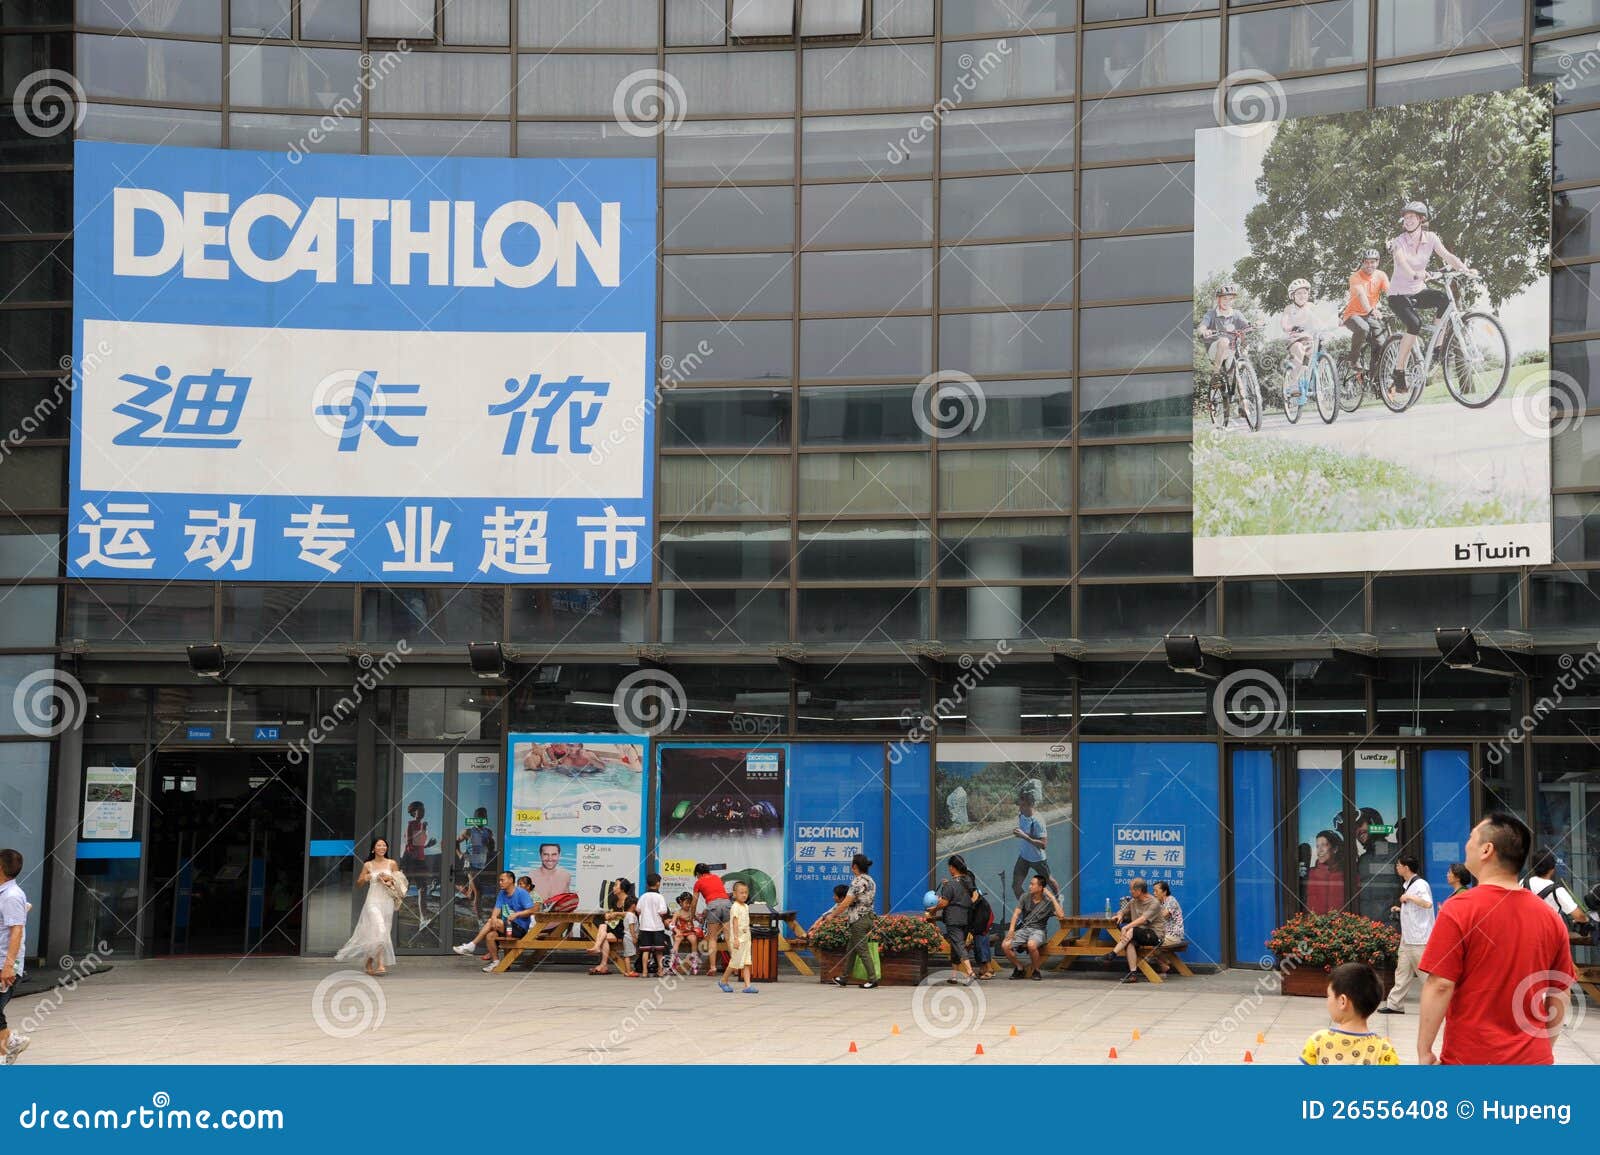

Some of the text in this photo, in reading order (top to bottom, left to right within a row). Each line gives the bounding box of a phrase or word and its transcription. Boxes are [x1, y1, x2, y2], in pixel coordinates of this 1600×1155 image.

[113, 187, 621, 289] DECATHLON
[112, 365, 610, 455] 迪卡侬
[76, 501, 646, 576] 运动专业超市
[257, 729, 277, 738] 入口
[798, 826, 859, 838] DECATHLON
[1117, 829, 1181, 842] DECATHLON
[1118, 848, 1181, 862] 迪卡侬
